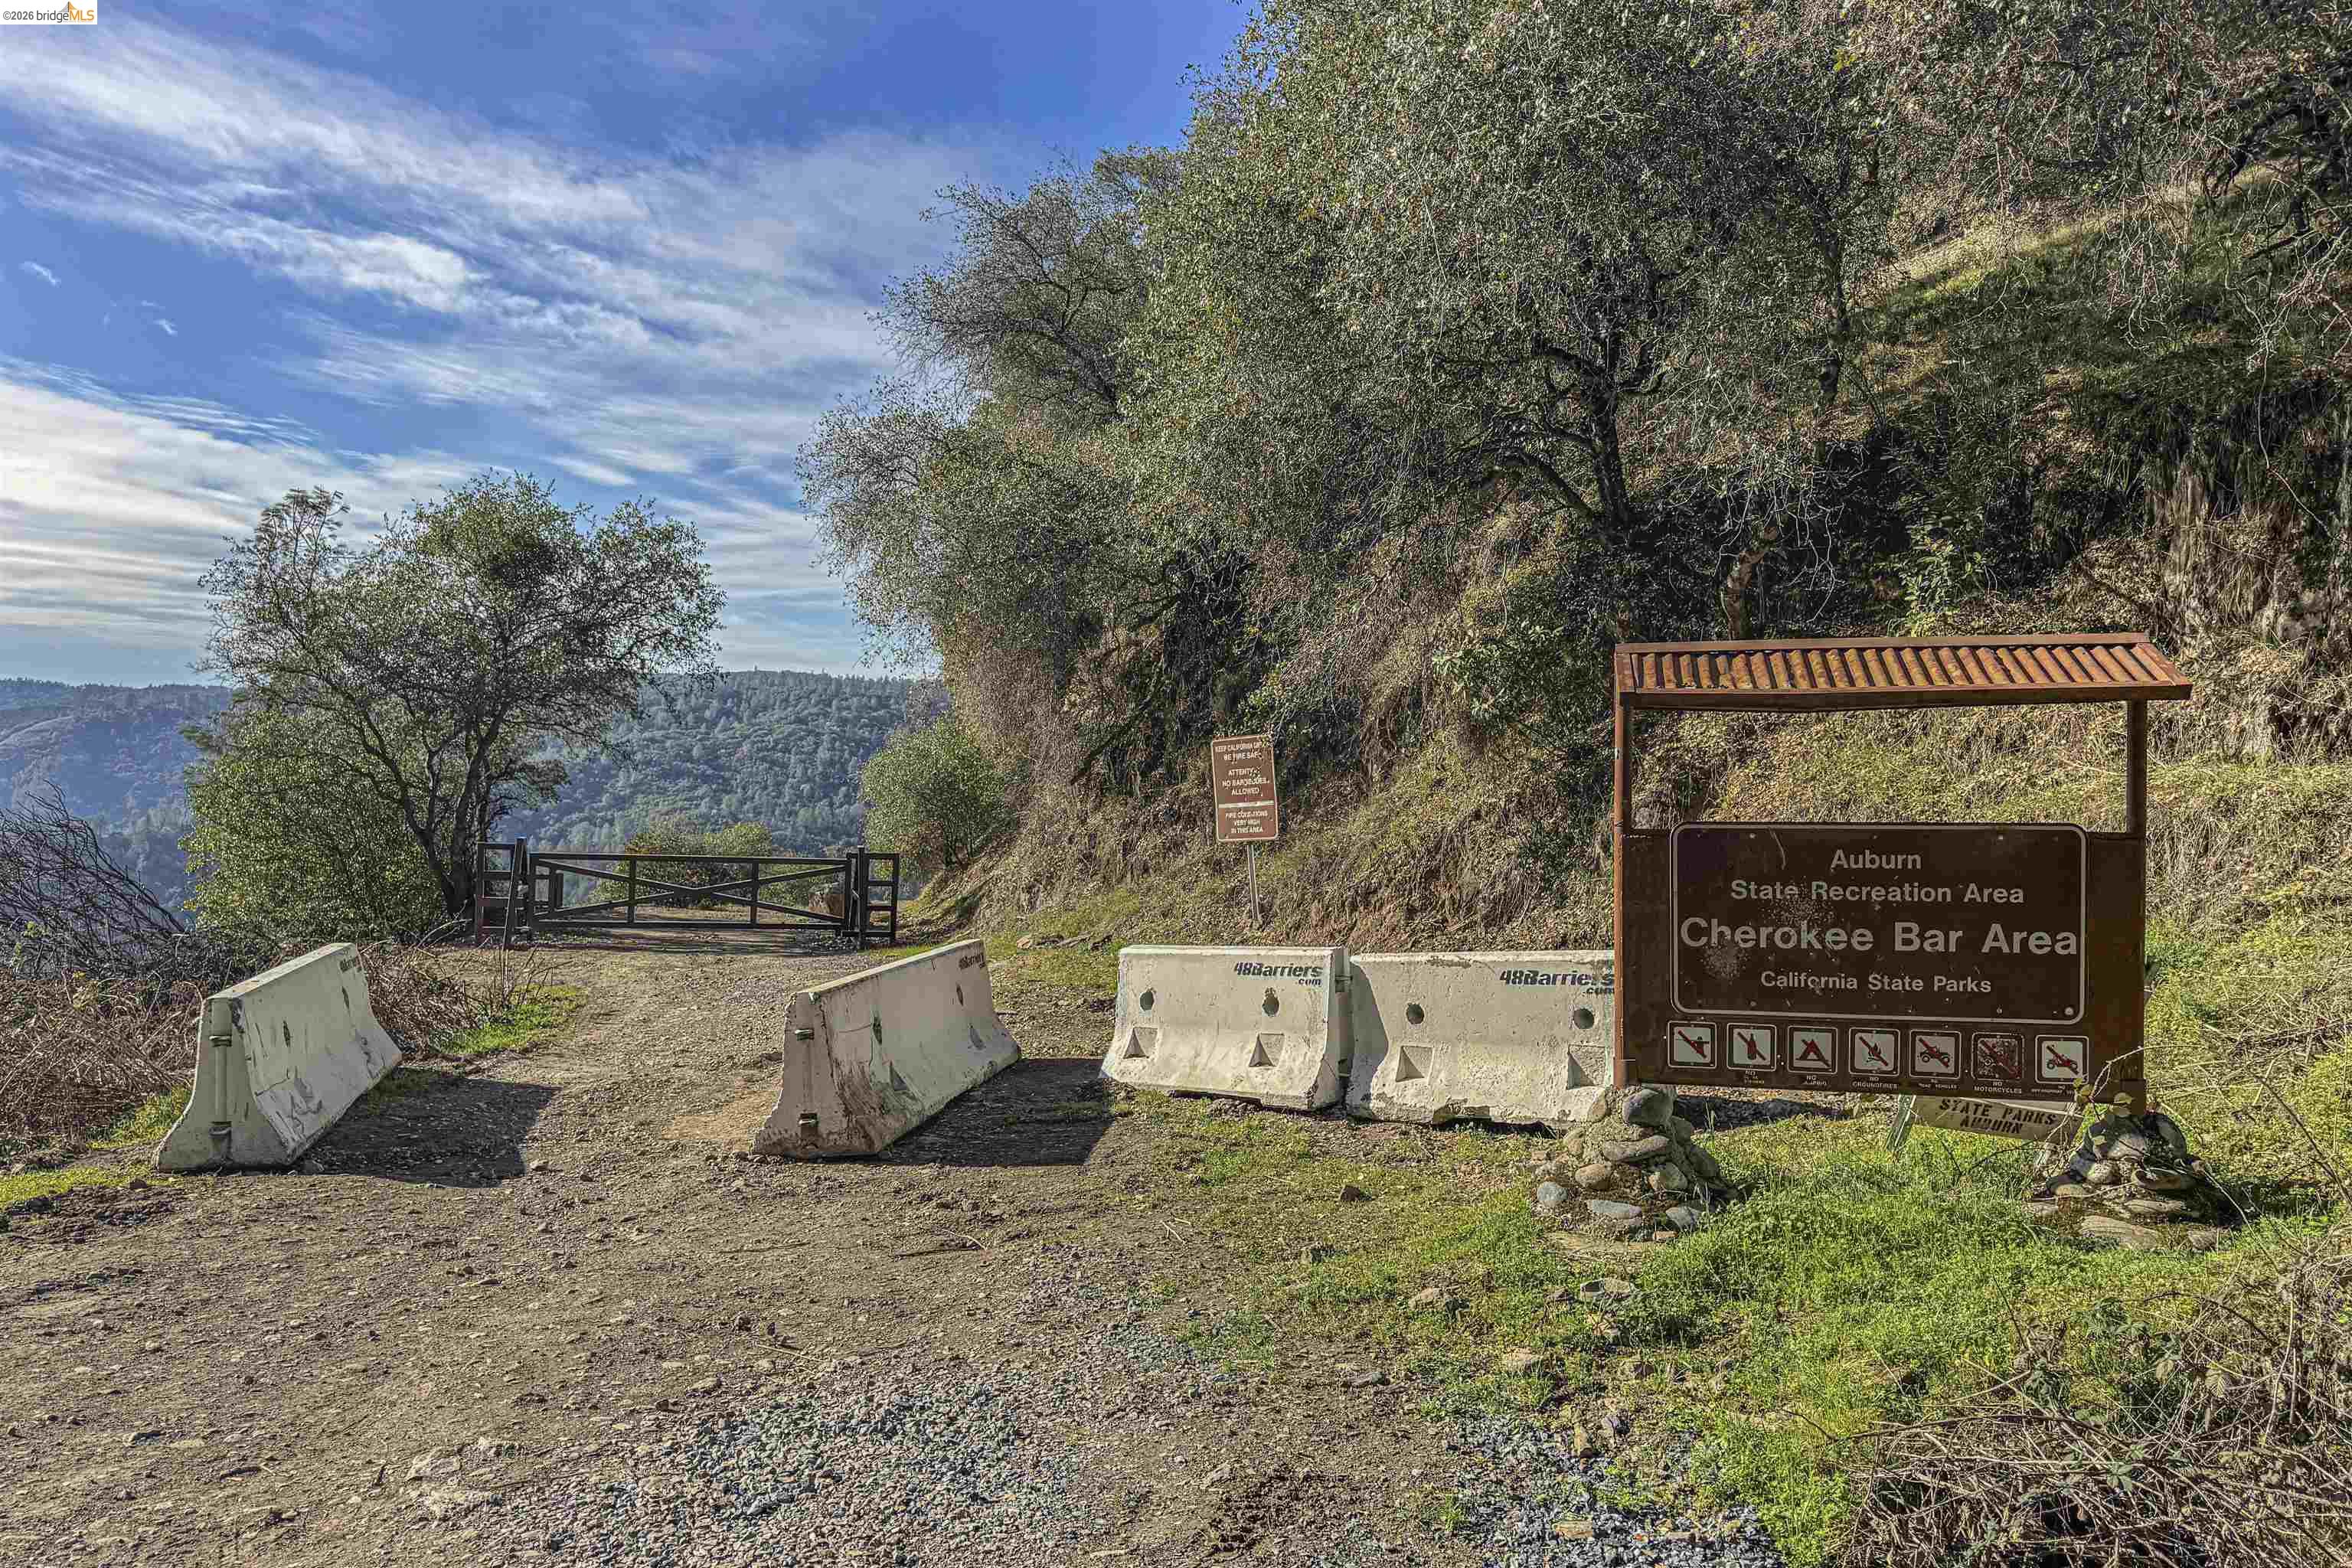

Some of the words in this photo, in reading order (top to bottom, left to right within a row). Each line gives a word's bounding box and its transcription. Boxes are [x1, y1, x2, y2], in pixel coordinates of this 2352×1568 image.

[1231, 787, 1259, 795] ALLOWED
[1830, 850, 1922, 871] Auburn
[1730, 880, 1799, 900] State
[1811, 881, 1952, 903] Recreation
[1963, 884, 2025, 903] Area
[1680, 917, 1874, 952] Cherokee
[1893, 922, 1964, 953] Bar
[1981, 923, 2078, 956] Area
[1233, 962, 1324, 977] 48Barriers
[1499, 969, 1615, 986] 48Barries
[1761, 971, 1858, 991] California
[1868, 973, 1924, 992] State
[1933, 975, 1992, 994] Parks
[1974, 1086, 2022, 1094] MOTORCYCLES
[1939, 1099, 1992, 1117] STATE
[2001, 1107, 2058, 1125] PARKS
[1959, 1116, 2024, 1135] AUBURN
